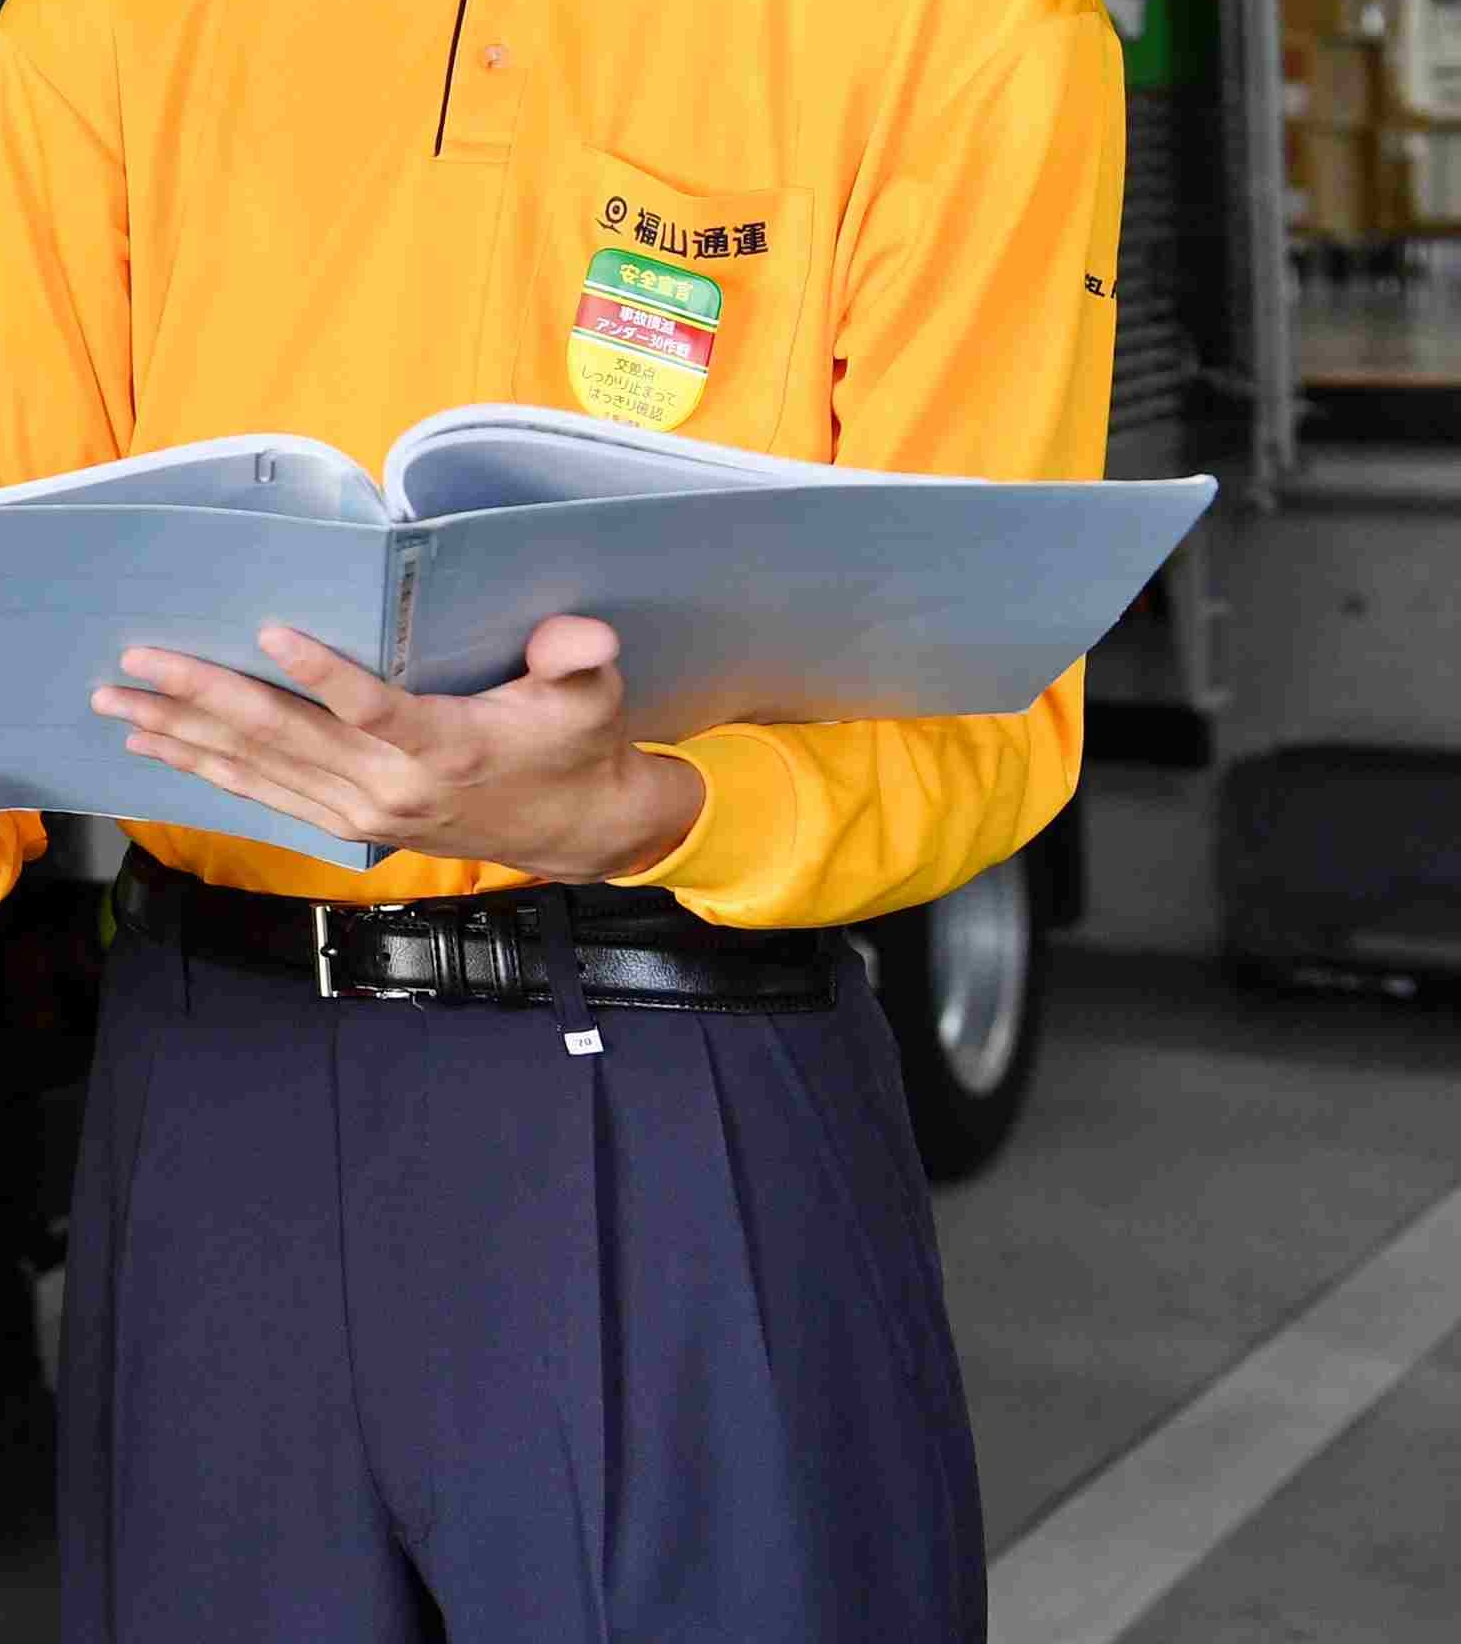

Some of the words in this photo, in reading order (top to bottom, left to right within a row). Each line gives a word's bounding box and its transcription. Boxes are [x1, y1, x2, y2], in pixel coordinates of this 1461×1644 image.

[634, 207, 769, 260] 福山通運
[619, 263, 693, 302] 安全宣言
[581, 365, 677, 406] しっかり止まって
